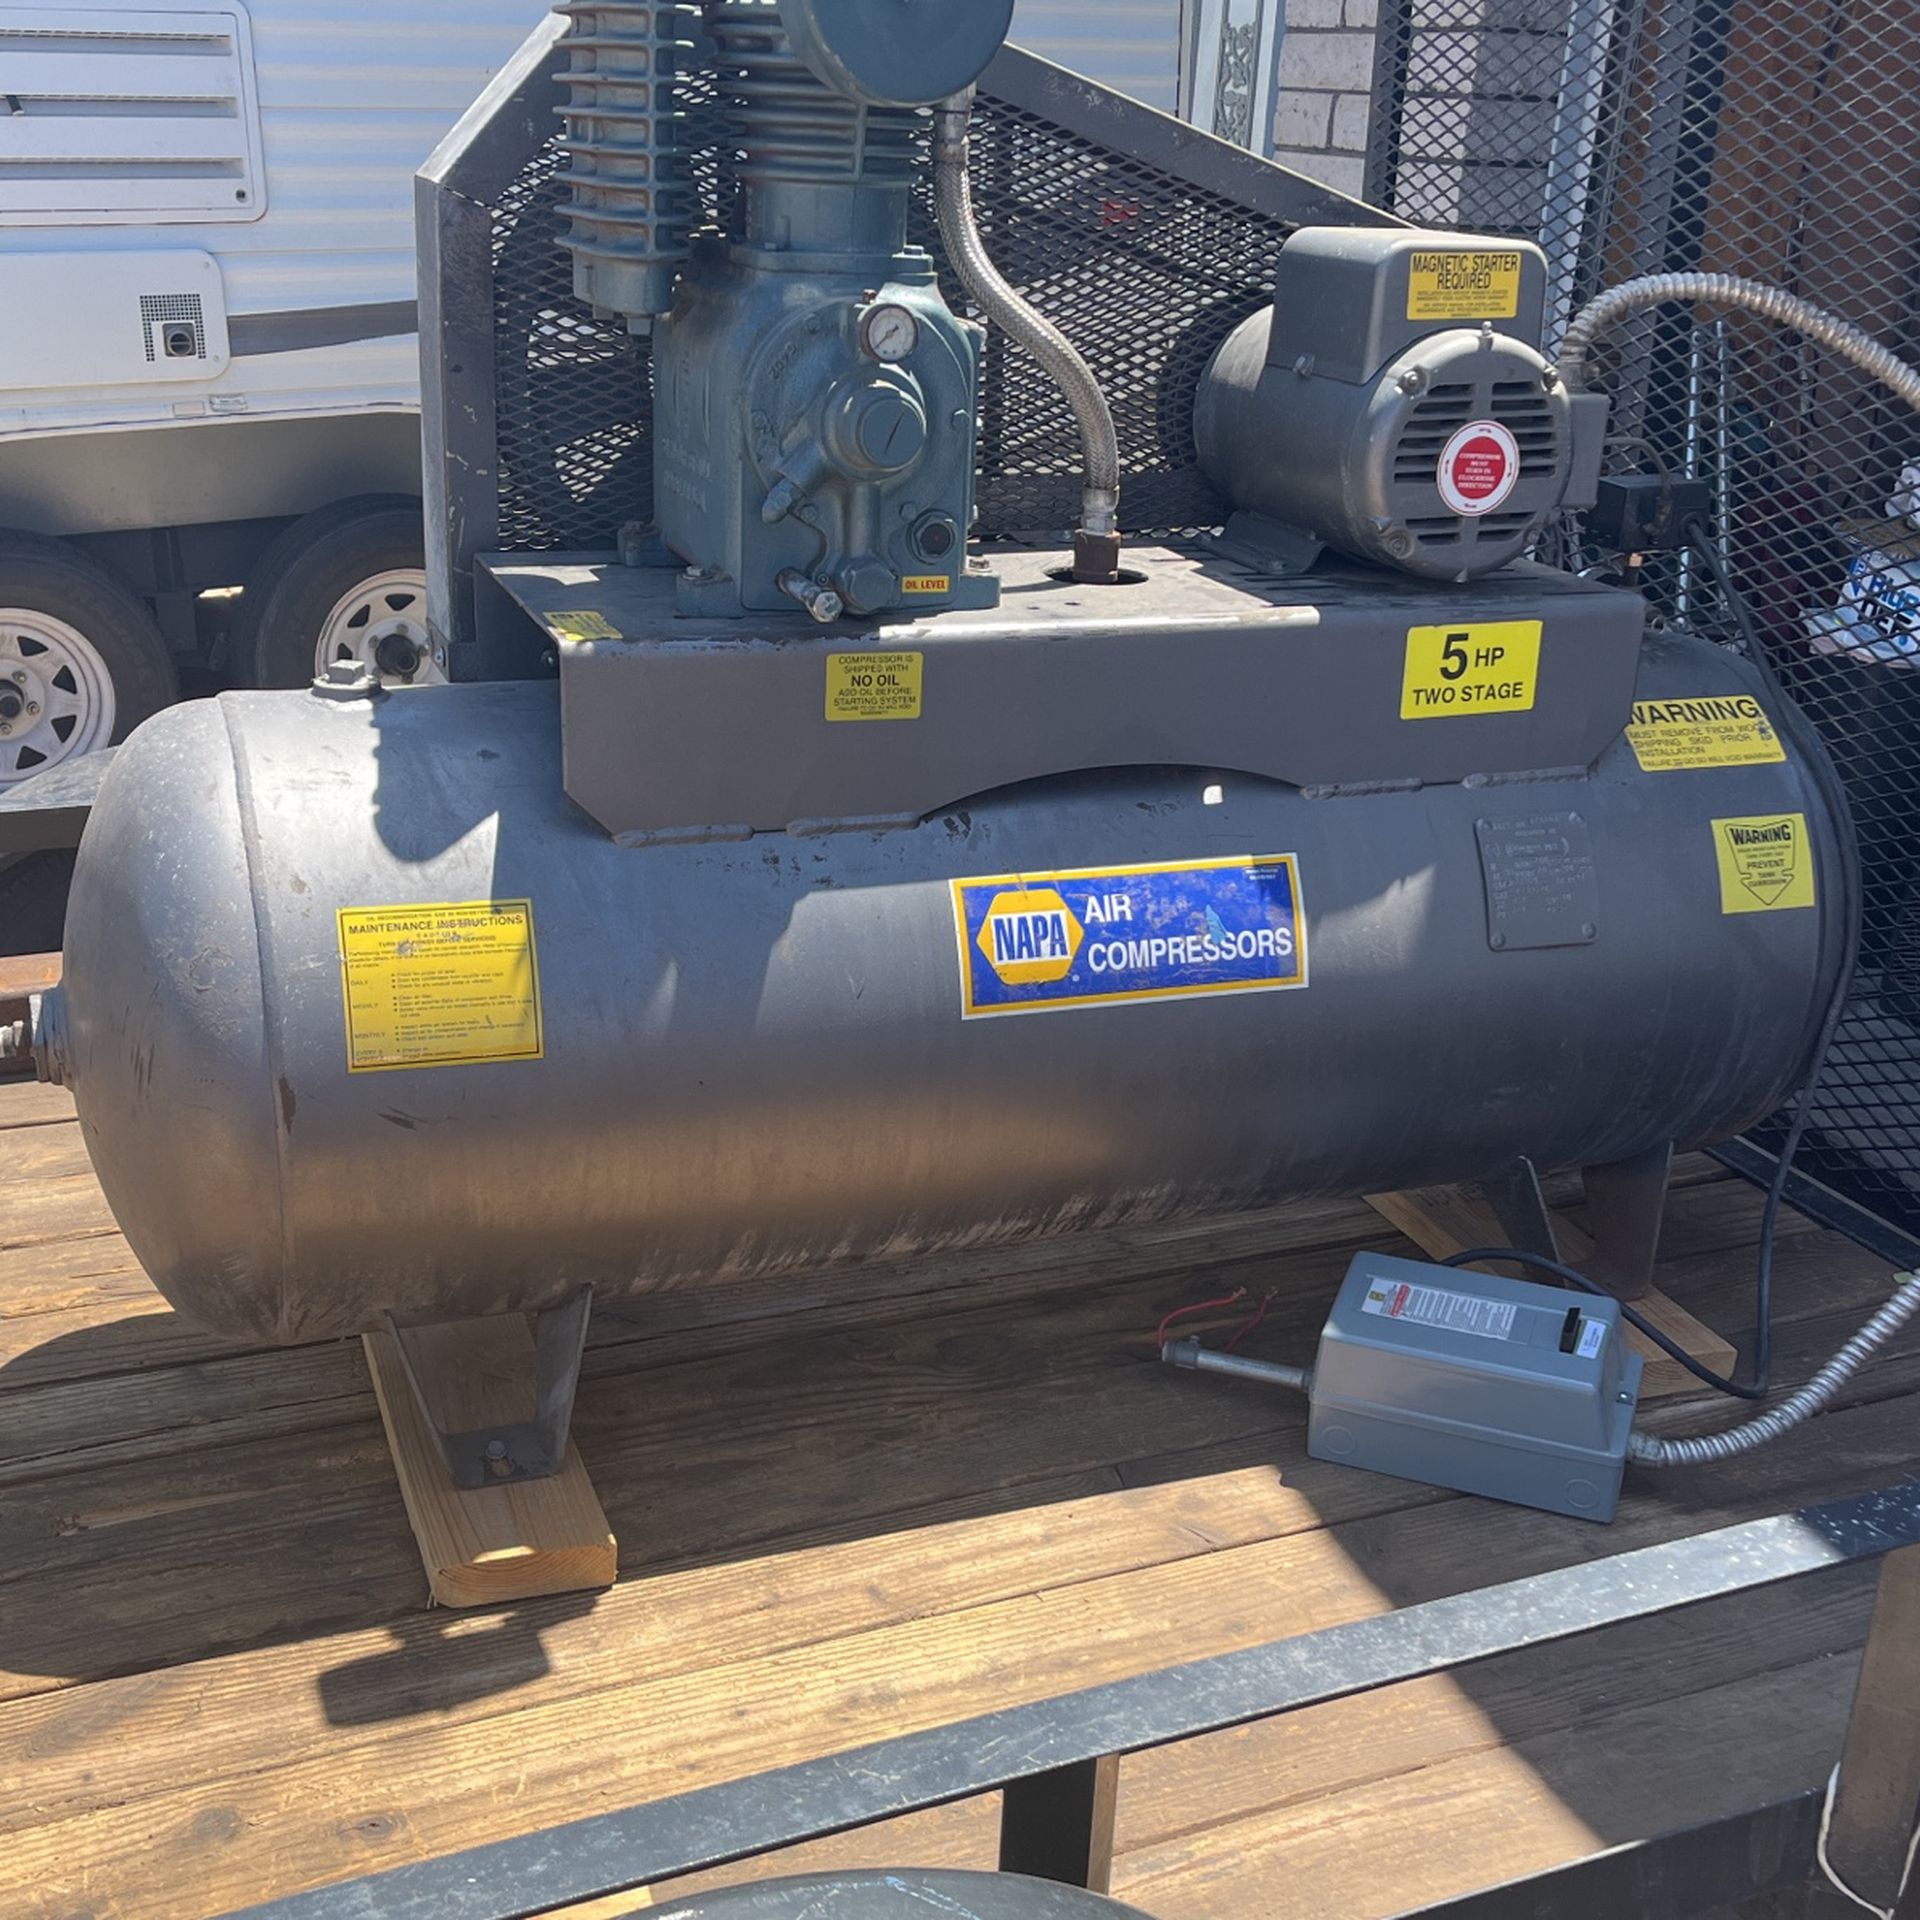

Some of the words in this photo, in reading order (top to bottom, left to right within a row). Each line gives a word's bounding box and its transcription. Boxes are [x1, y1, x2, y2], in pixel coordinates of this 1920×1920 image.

[1412, 255, 1468, 273] MAGNETIC
[1472, 254, 1518, 272] STARTER
[1437, 272, 1491, 290] REQUIRED
[905, 580, 918, 590] OIL
[921, 580, 945, 590] LEVEL
[838, 655, 903, 664] COMPRESSOR
[1440, 633, 1469, 680] 5
[1474, 647, 1504, 668] HP
[844, 665, 882, 674] SHIPPED
[885, 664, 909, 672] WITH
[851, 674, 872, 687] NO
[877, 674, 900, 687] OIL
[876, 687, 911, 696] BEFORE
[1413, 687, 1456, 706] TWO
[1461, 682, 1523, 702] STAGE
[834, 697, 878, 707] STARTING
[880, 696, 916, 705] SYSTEM
[1660, 727, 1704, 737] REMOVE
[1705, 725, 1735, 734] FROM
[1633, 738, 1682, 748] SHIPPING
[1720, 733, 1752, 743] PRIOR
[1729, 823, 1791, 845] WARNING
[1746, 858, 1784, 869] PREVENT
[1084, 894, 1132, 924] AIR
[349, 920, 433, 934] MAINTENANCE
[437, 914, 523, 929] INSTRUCTIONS
[993, 912, 1068, 962] NAPA
[1087, 927, 1293, 972] COMPRESSORS
